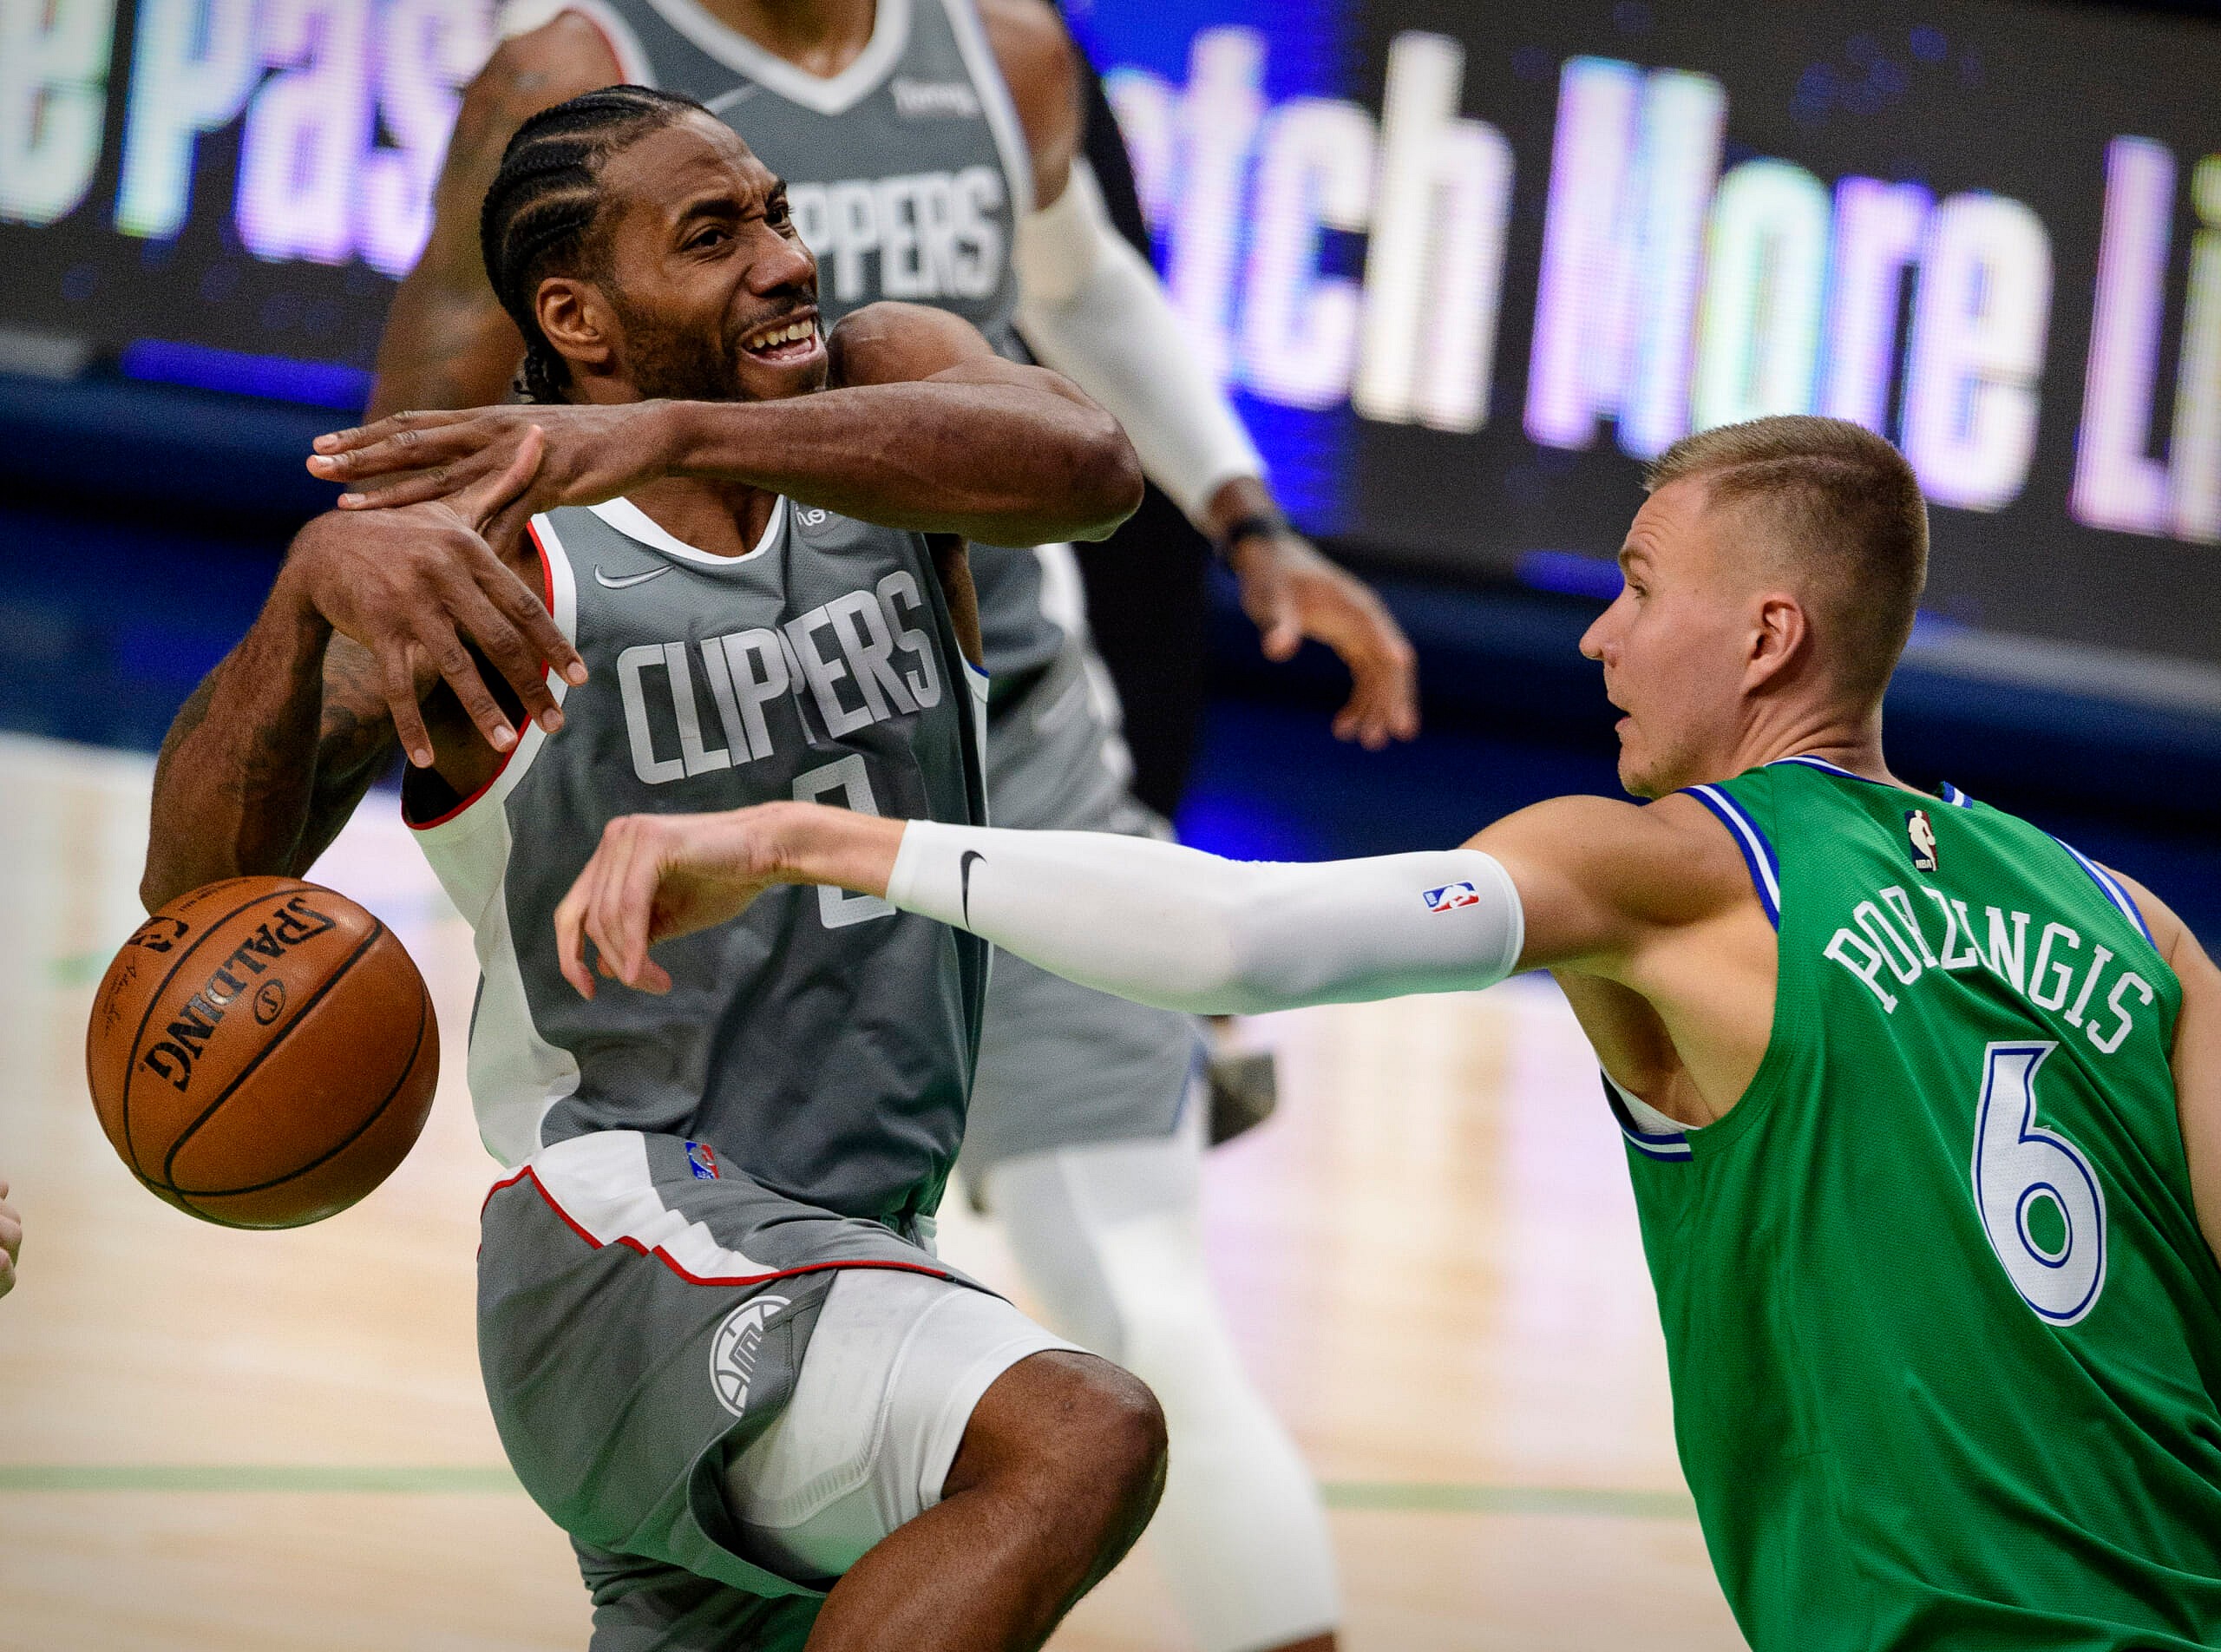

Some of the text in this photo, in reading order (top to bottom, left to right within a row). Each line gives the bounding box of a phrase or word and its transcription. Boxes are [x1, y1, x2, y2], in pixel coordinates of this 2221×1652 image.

[785, 167, 1000, 302] PPERS
[1100, 24, 1517, 436] tch
[1520, 54, 2053, 514] More
[143, 896, 337, 1093] SPALDING
[1970, 1041, 2107, 1327] 6
